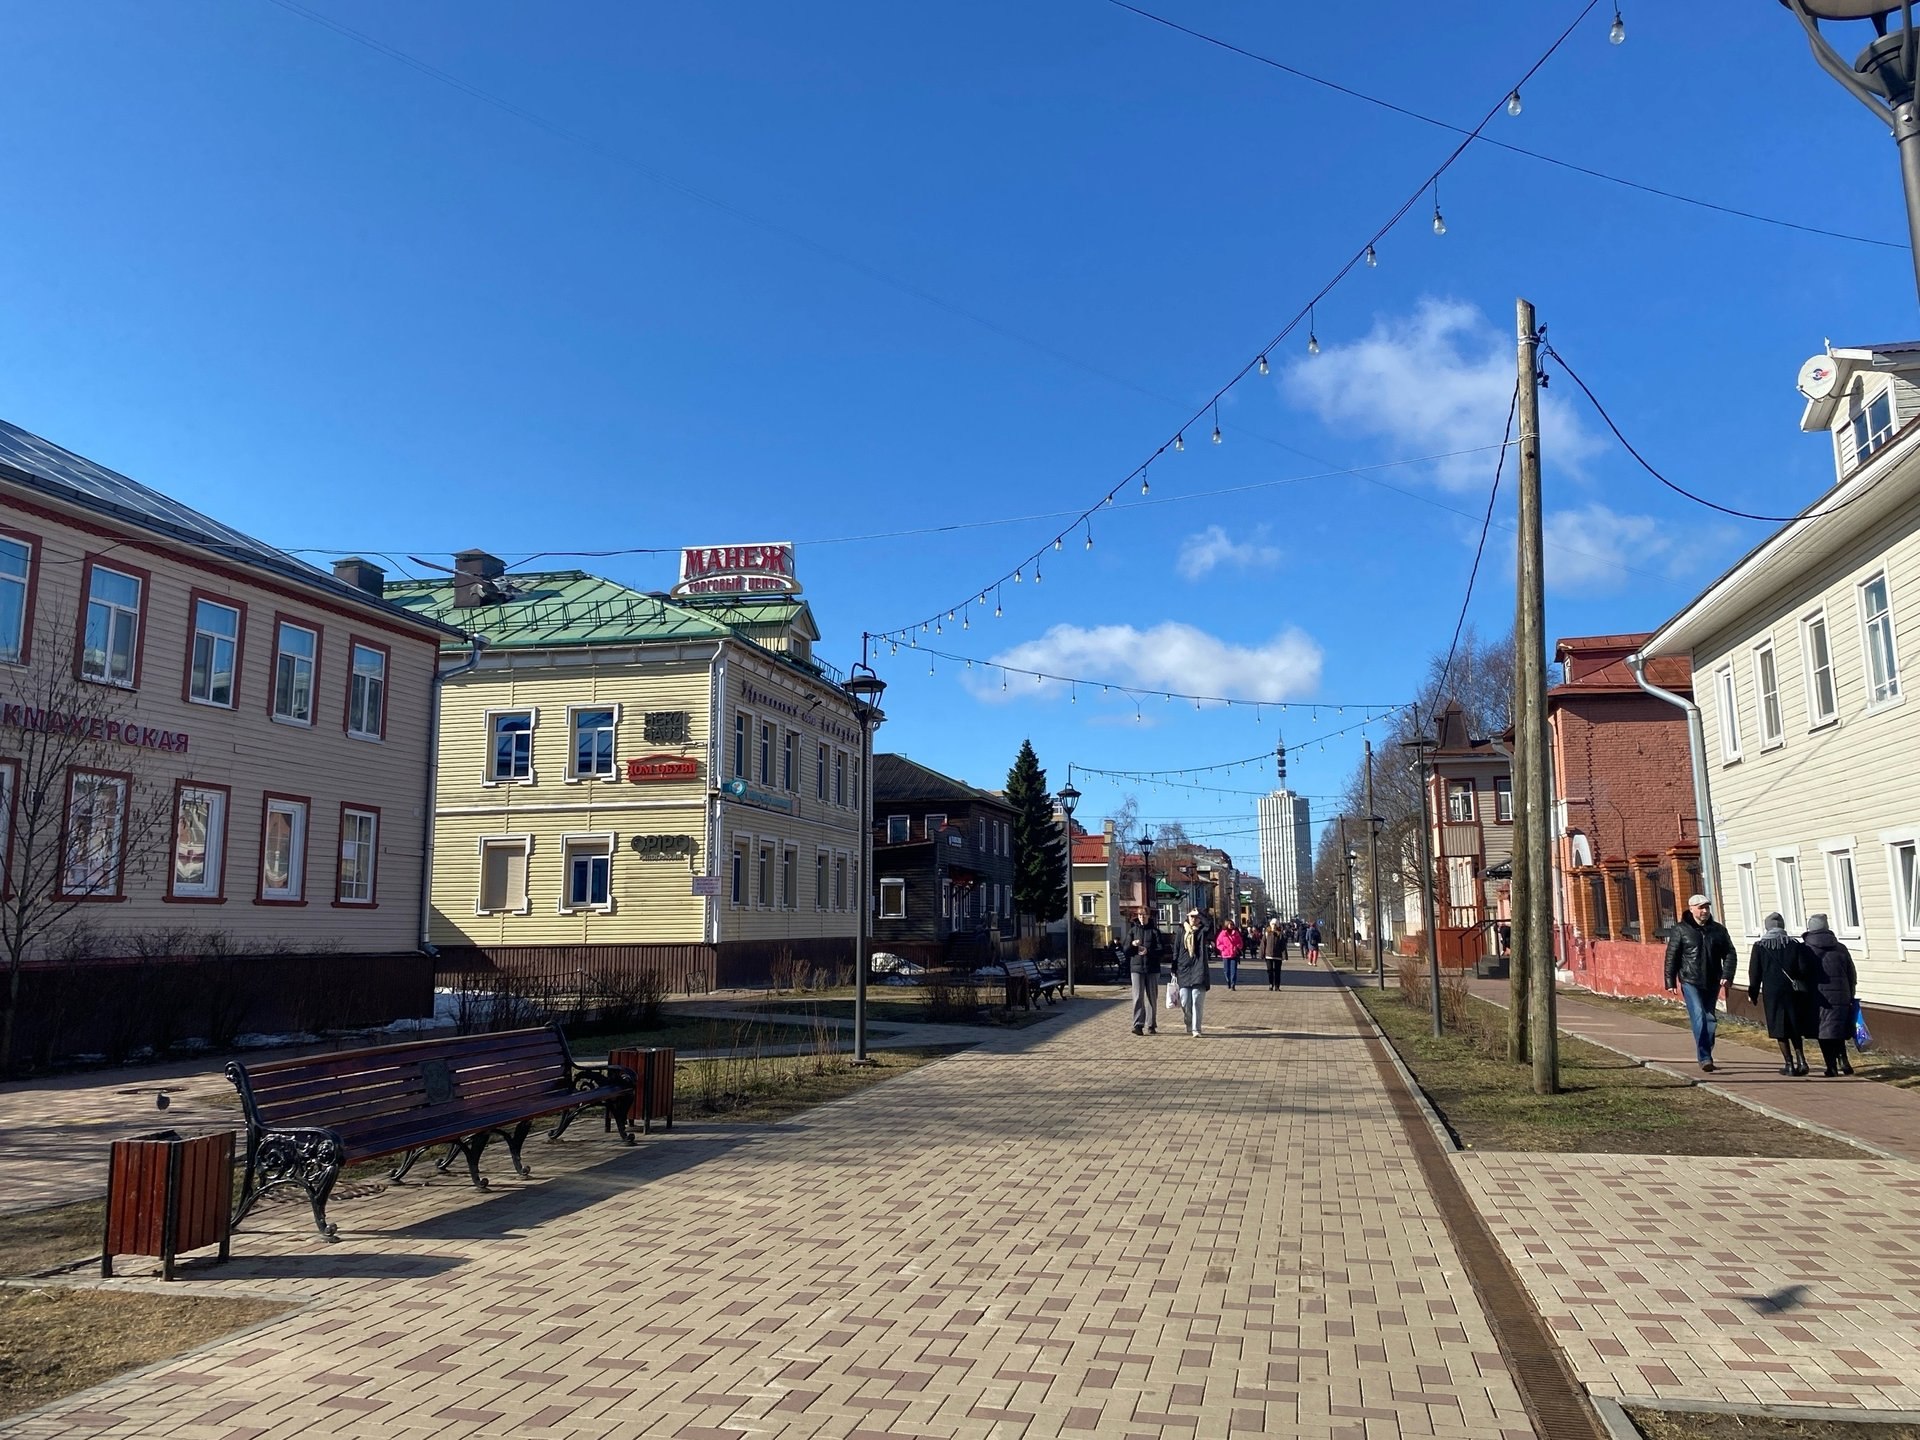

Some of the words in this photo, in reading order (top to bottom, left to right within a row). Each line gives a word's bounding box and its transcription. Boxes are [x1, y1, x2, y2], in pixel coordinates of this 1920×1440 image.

[684, 546, 786, 579] МАНЕЖ
[689, 576, 742, 593] ТОРГОВЫЙ
[748, 577, 781, 591] ЦЕНТР
